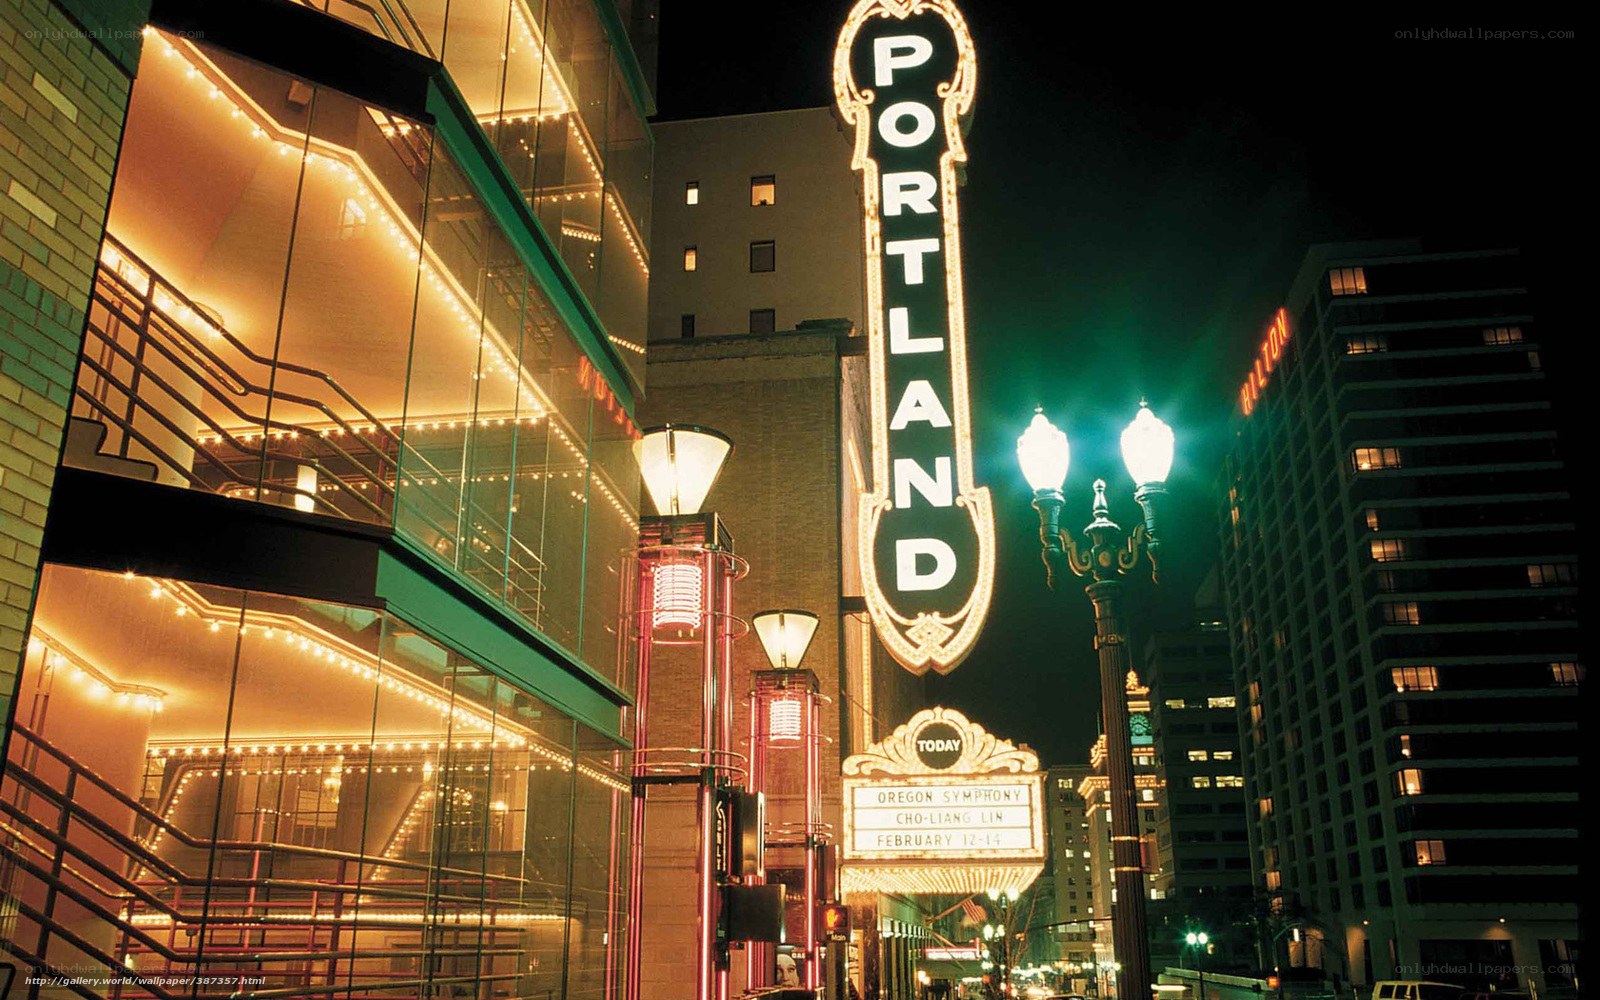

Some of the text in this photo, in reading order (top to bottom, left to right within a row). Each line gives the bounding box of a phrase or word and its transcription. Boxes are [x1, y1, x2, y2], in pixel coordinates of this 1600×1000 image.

[874, 34, 957, 592] PORTLAND
[1241, 307, 1288, 417] HILTON
[917, 739, 961, 752] TODAY
[878, 789, 1021, 804] OREGON SYMPHONY
[896, 811, 1003, 825] CHO-LIANG LIN
[877, 833, 1001, 847] FEBRUARY 12-14
